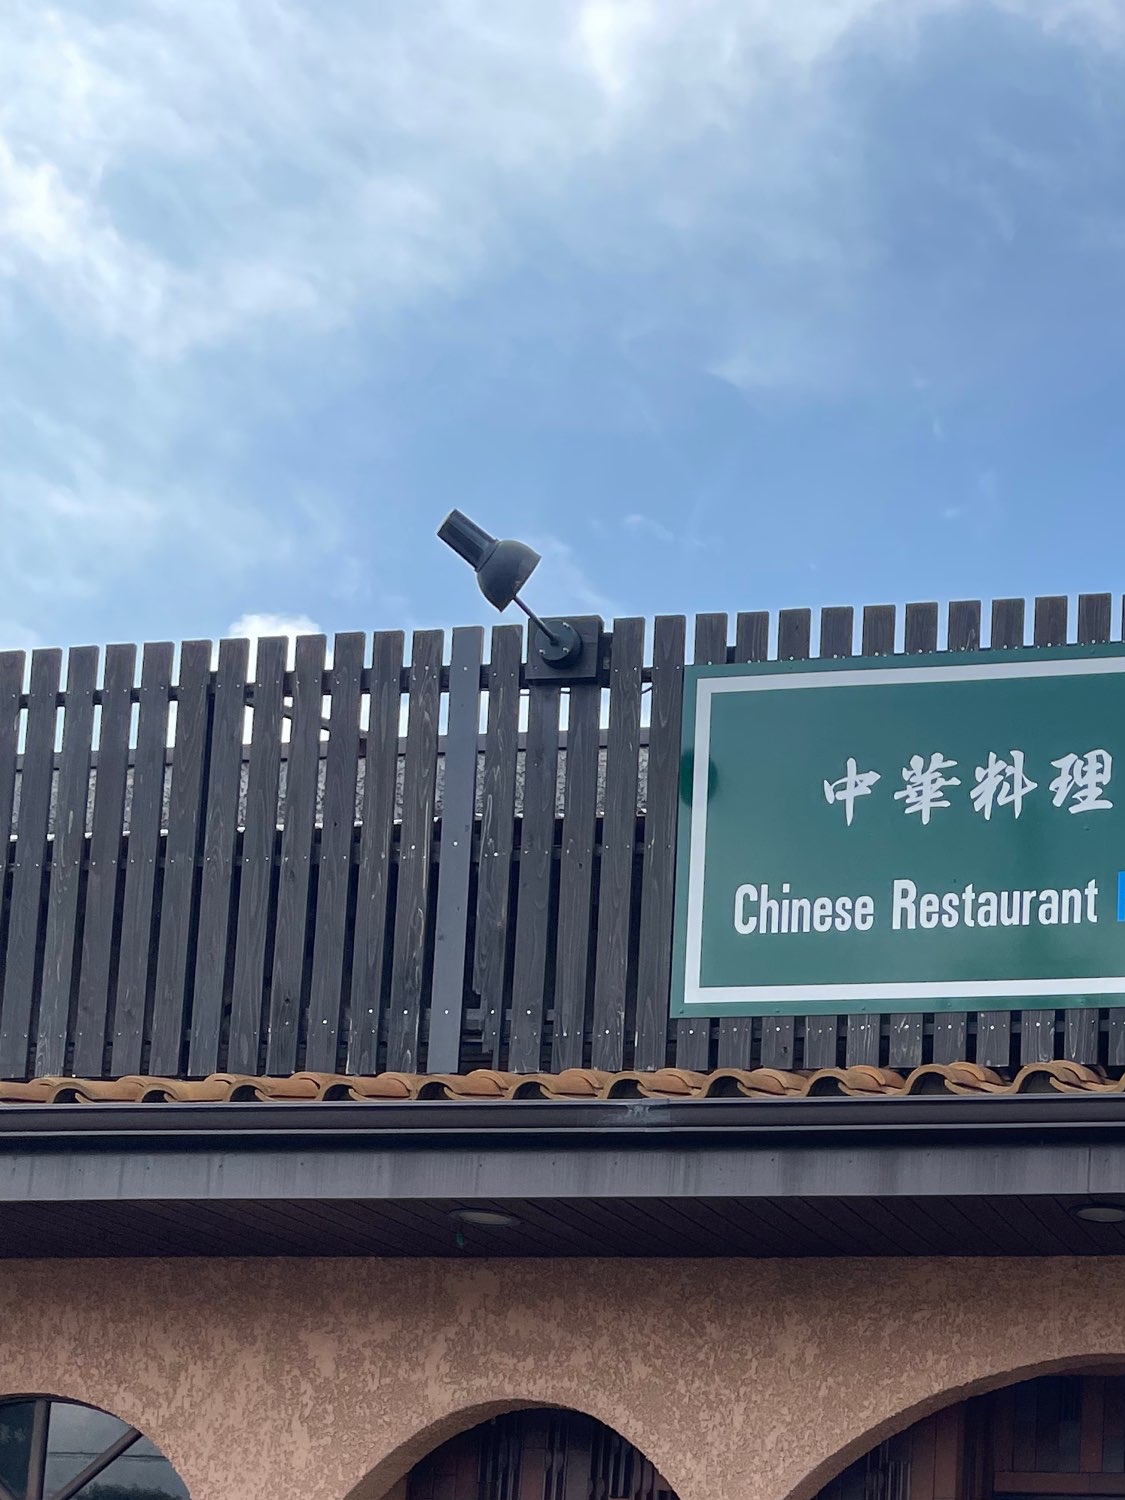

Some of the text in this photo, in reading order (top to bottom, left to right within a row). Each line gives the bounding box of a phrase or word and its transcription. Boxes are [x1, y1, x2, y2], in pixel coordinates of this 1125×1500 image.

[824, 750, 1114, 827] 中華料理
[735, 883, 874, 935] Chinese
[893, 879, 1099, 931] Restaurant
